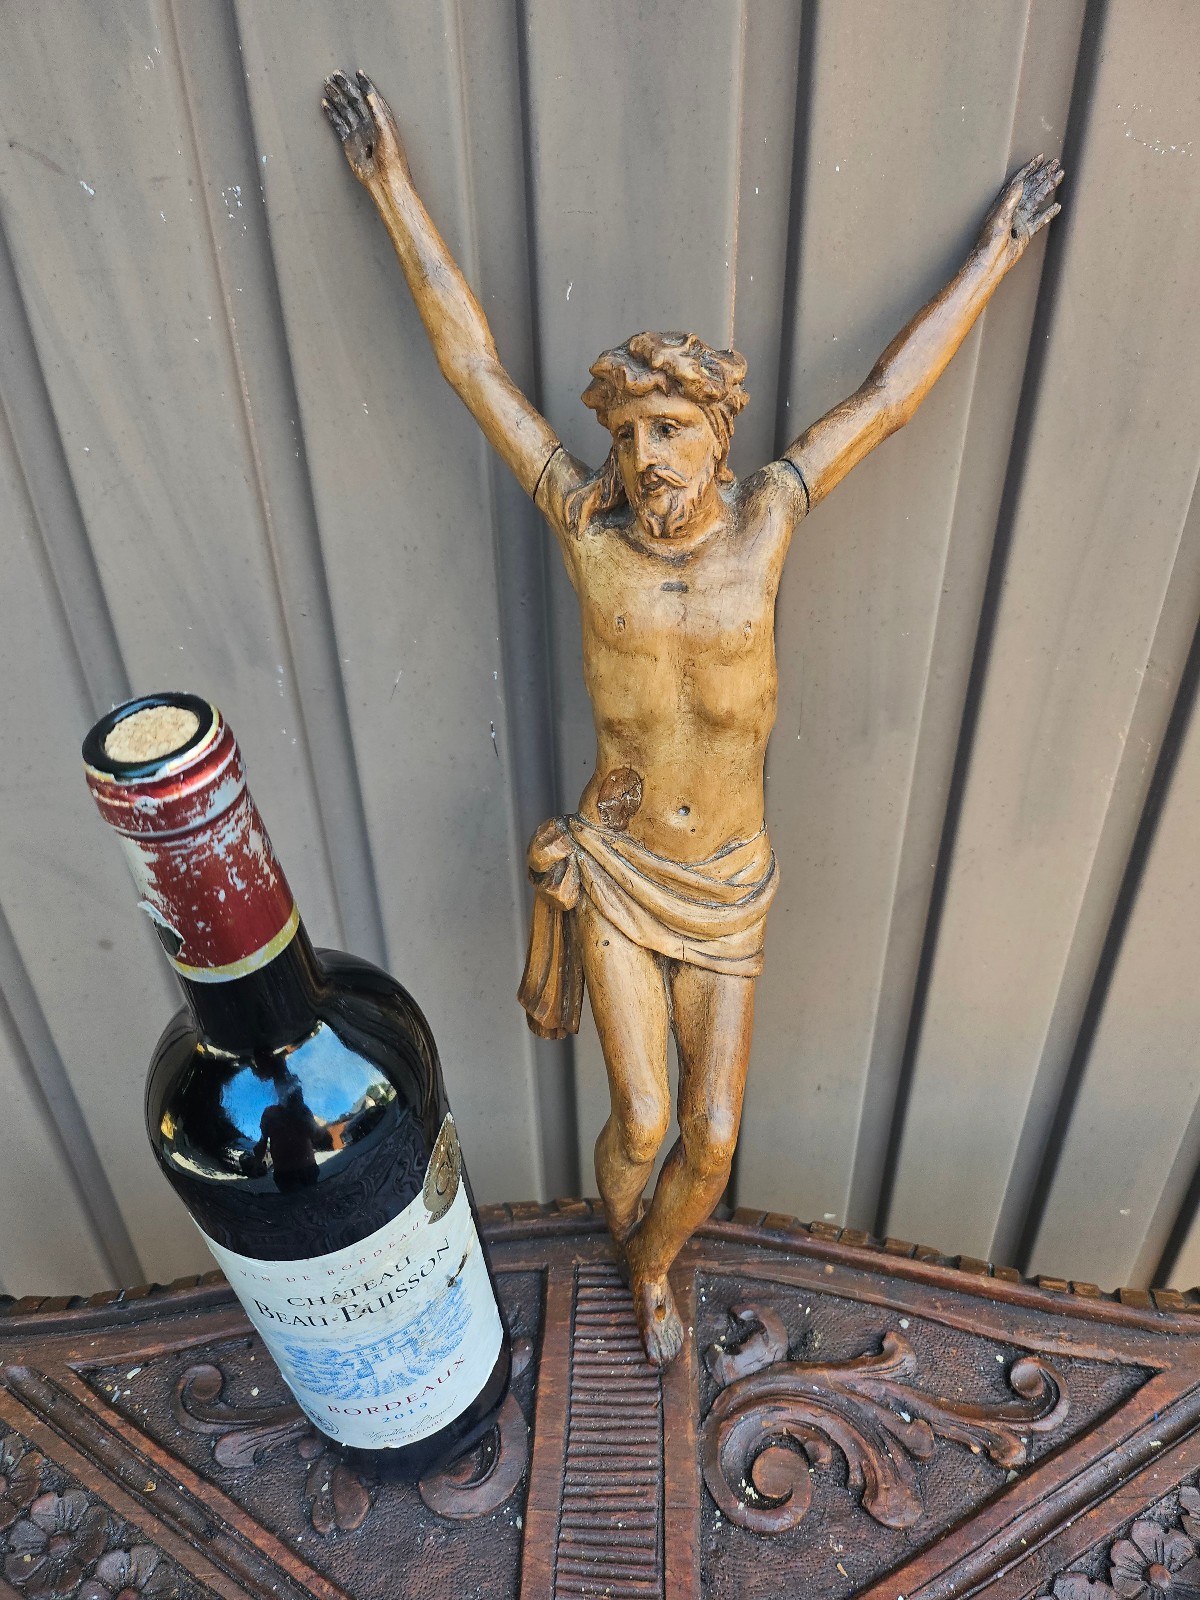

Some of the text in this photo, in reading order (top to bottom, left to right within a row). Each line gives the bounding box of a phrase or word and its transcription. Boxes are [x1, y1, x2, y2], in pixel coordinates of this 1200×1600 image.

[287, 1255, 412, 1307] CHÂTEAU
[327, 1353, 465, 1416] BORDEAUX
[381, 1401, 428, 1424] 2019
